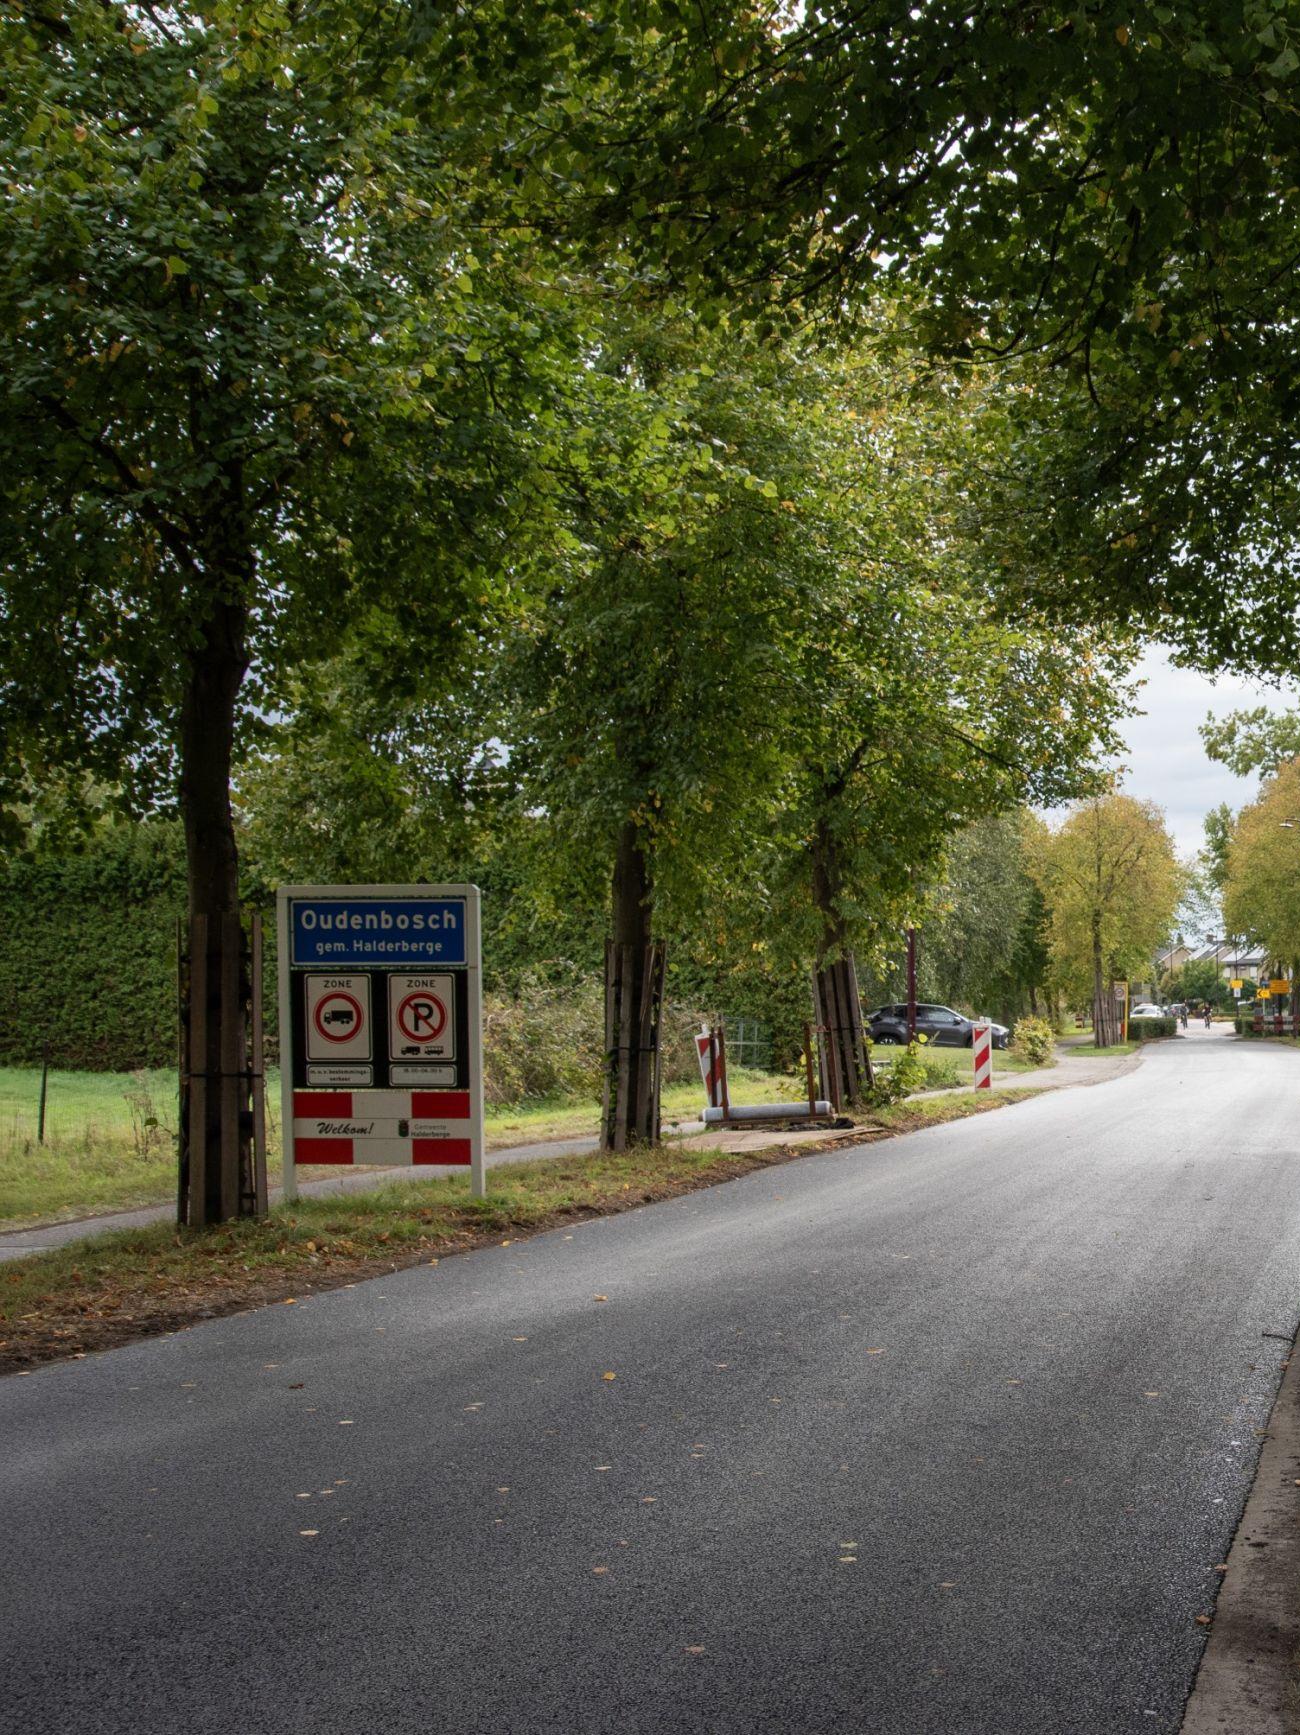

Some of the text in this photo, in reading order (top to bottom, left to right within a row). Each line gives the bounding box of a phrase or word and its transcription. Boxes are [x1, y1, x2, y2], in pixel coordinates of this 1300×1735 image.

[301, 909, 457, 930] Oudenbosch
[315, 939, 443, 956] gem. Halderberge
[323, 980, 352, 989] ZONE
[407, 980, 436, 988] ZONE
[316, 1121, 375, 1135] Welkom!
